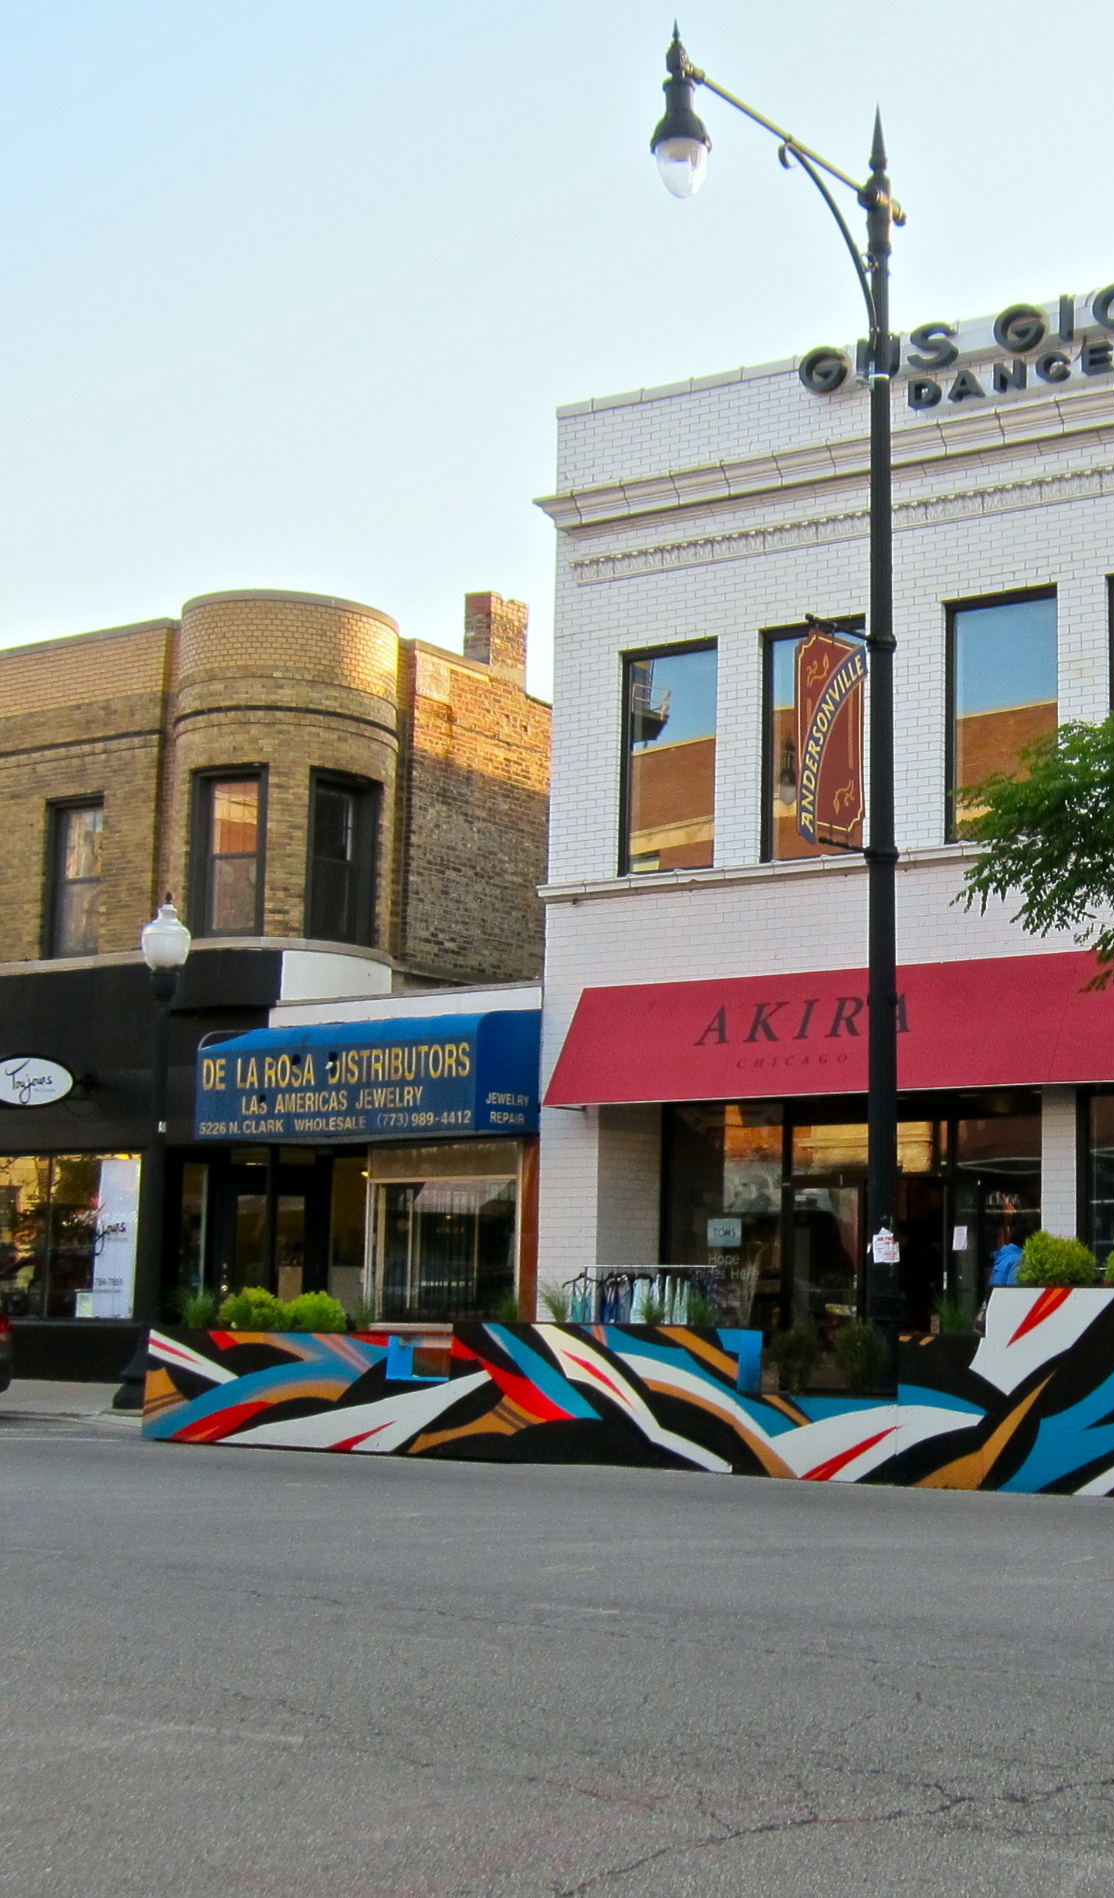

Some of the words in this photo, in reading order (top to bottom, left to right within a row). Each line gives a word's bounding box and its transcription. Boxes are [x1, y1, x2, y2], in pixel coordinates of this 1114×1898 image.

[799, 321, 960, 394] GUS
[801, 654, 864, 834] ANDERSONVILLE
[736, 1052, 848, 1069] CHICAGO
[203, 1058, 227, 1090] DE
[236, 1057, 259, 1089] LA
[264, 1053, 315, 1089] ROSA
[241, 1096, 268, 1115] LAS
[274, 1090, 348, 1114] AMERICAS
[355, 1086, 423, 1110] JEWELRY
[485, 1092, 530, 1107] JEWELRY
[199, 1122, 226, 1135] 5226
[228, 1122, 241, 1135] N.
[243, 1119, 284, 1133] CLARK
[294, 1115, 366, 1132] WHOLESALE
[376, 1112, 409, 1128] (773)
[411, 1110, 471, 1127] 989-4412
[490, 1111, 525, 1124] REPAIR
[713, 1227, 736, 1238] TOMS
[708, 1251, 740, 1266] Hope
